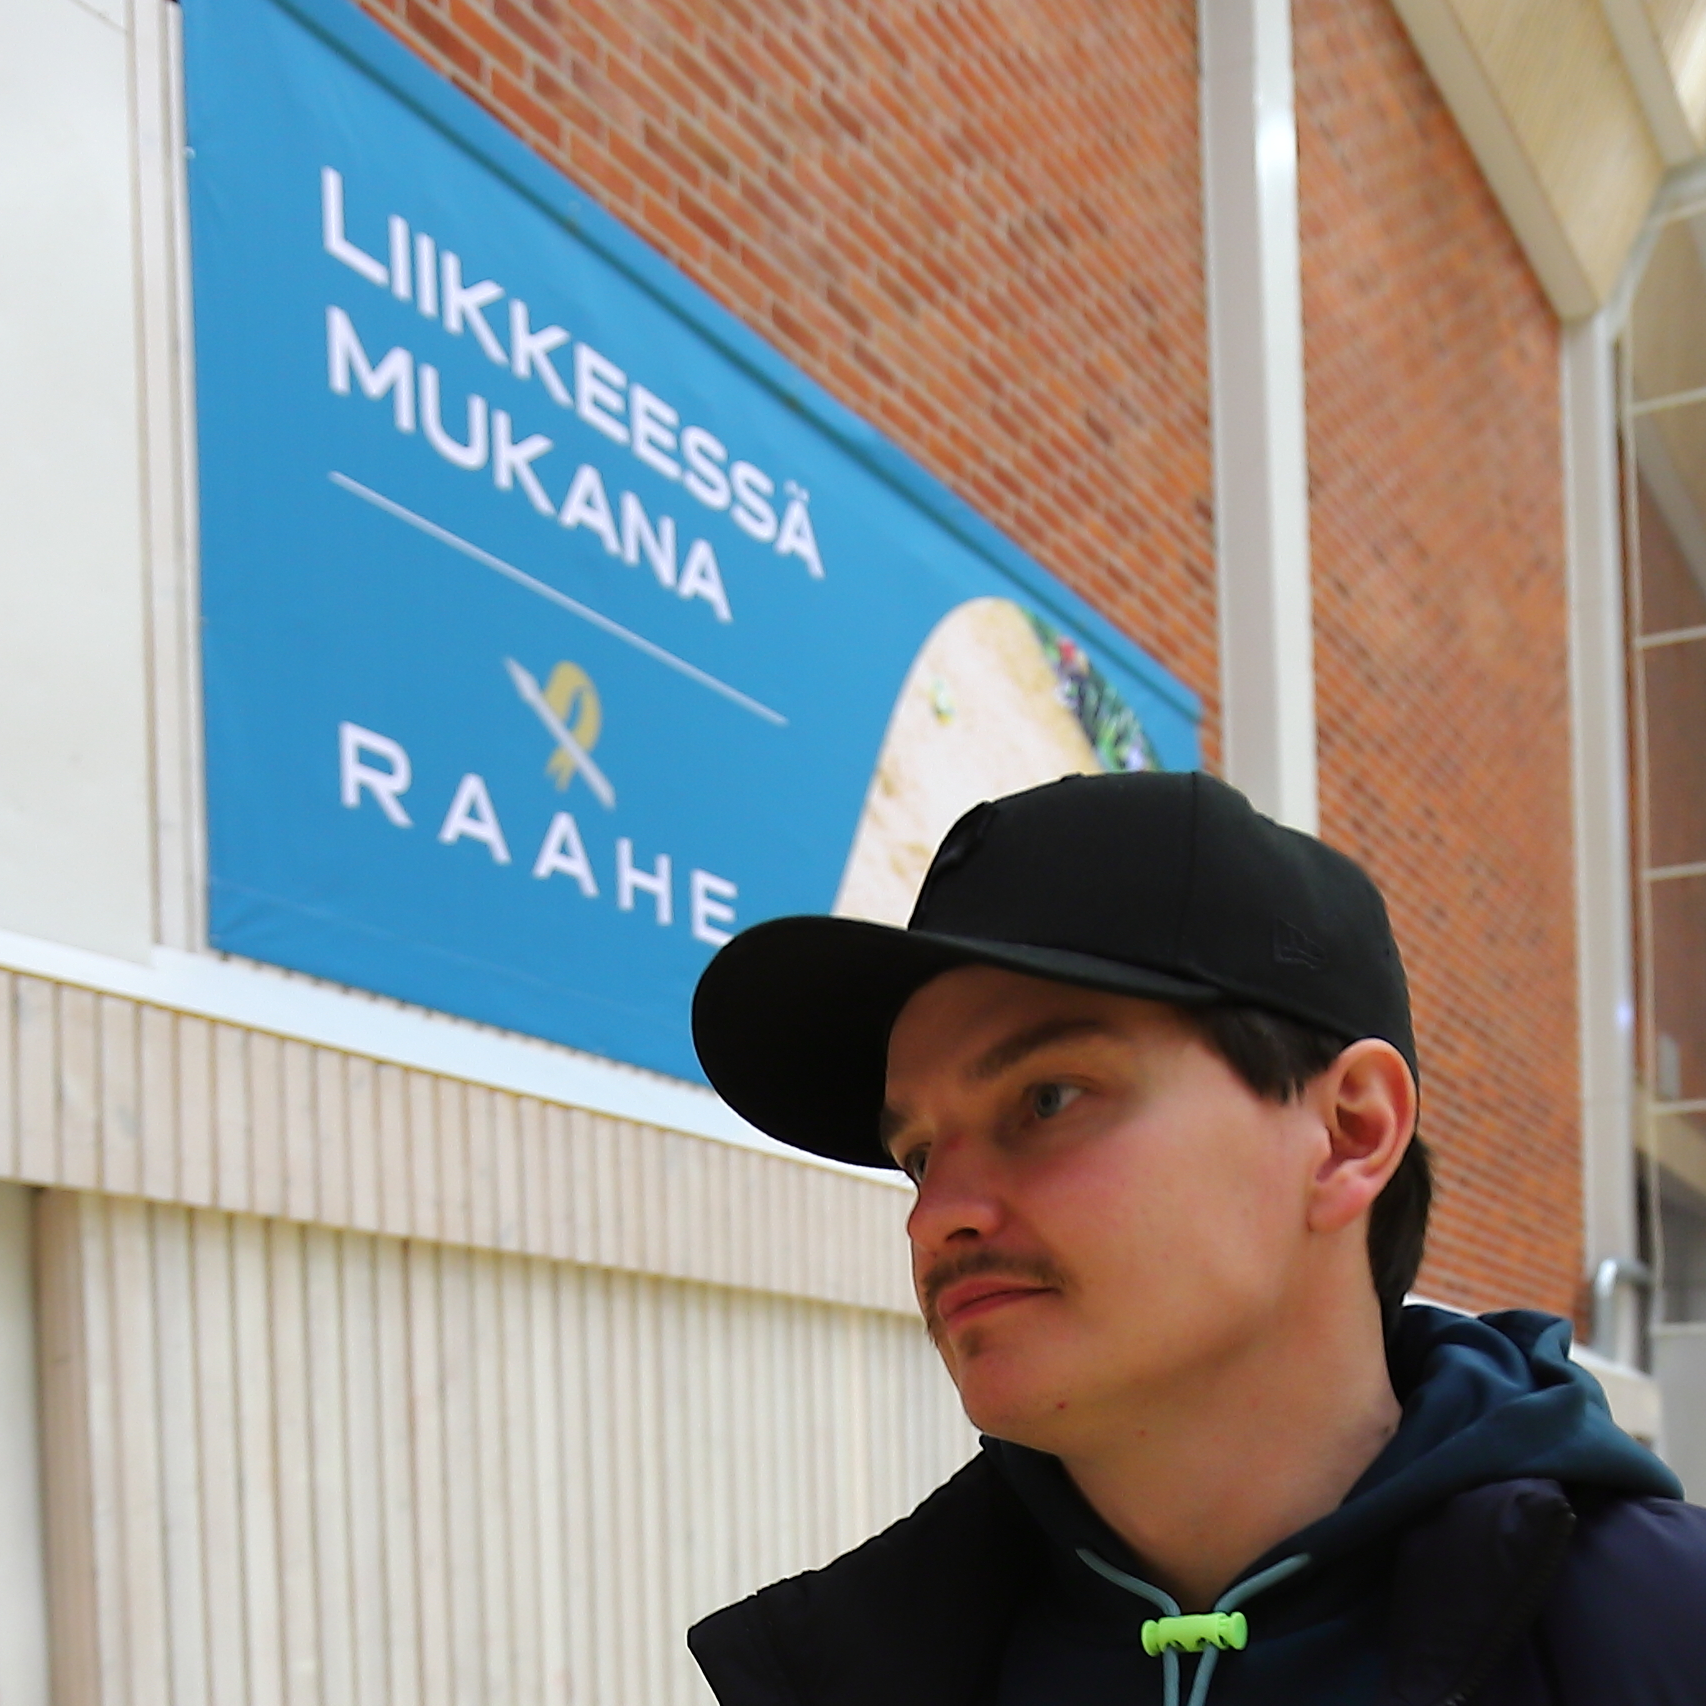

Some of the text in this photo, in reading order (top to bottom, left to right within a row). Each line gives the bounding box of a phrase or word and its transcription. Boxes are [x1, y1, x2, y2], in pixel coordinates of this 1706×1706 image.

[320, 166, 825, 578] LIIKKEESSÄ
[326, 305, 733, 622] MUKANA
[337, 721, 740, 943] RAAHE
